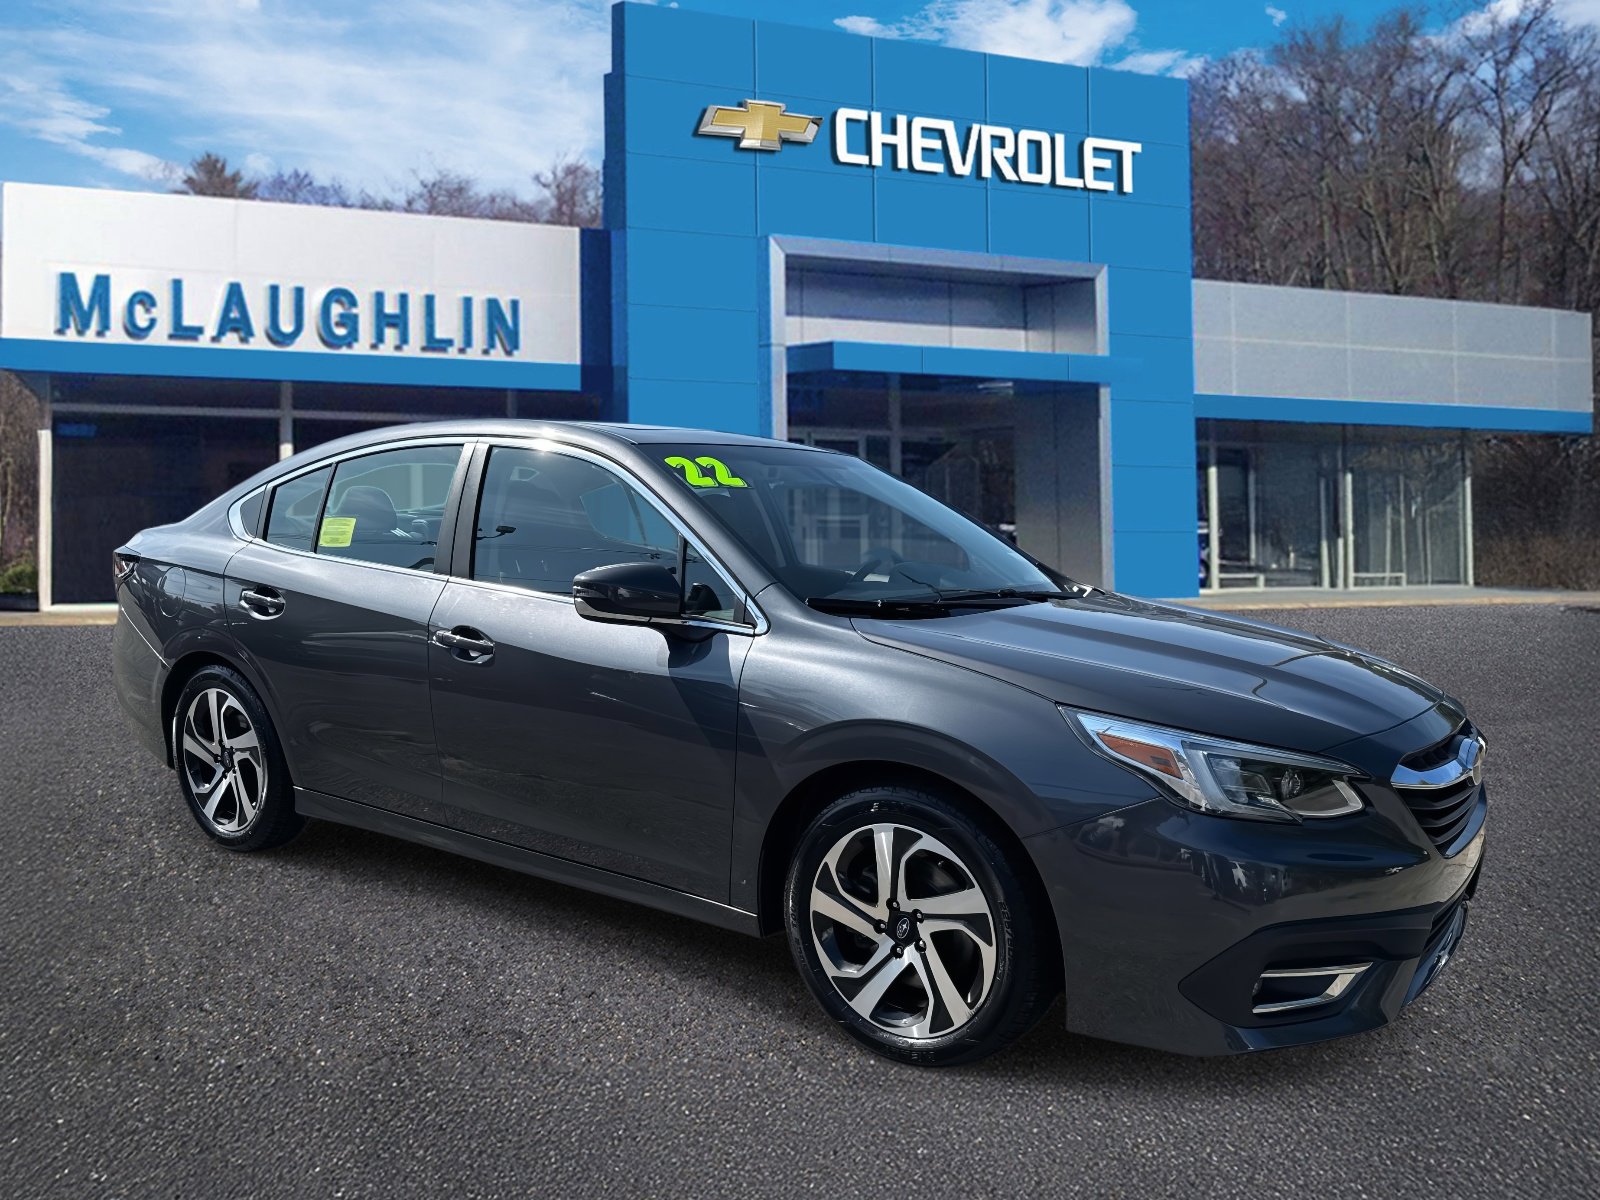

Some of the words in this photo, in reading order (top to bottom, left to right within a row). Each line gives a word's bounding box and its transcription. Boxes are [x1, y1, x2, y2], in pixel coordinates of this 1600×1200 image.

[835, 107, 1142, 193] CHEVROLET
[56, 271, 520, 356] McLAUGHLIN
[664, 456, 748, 488] 22
